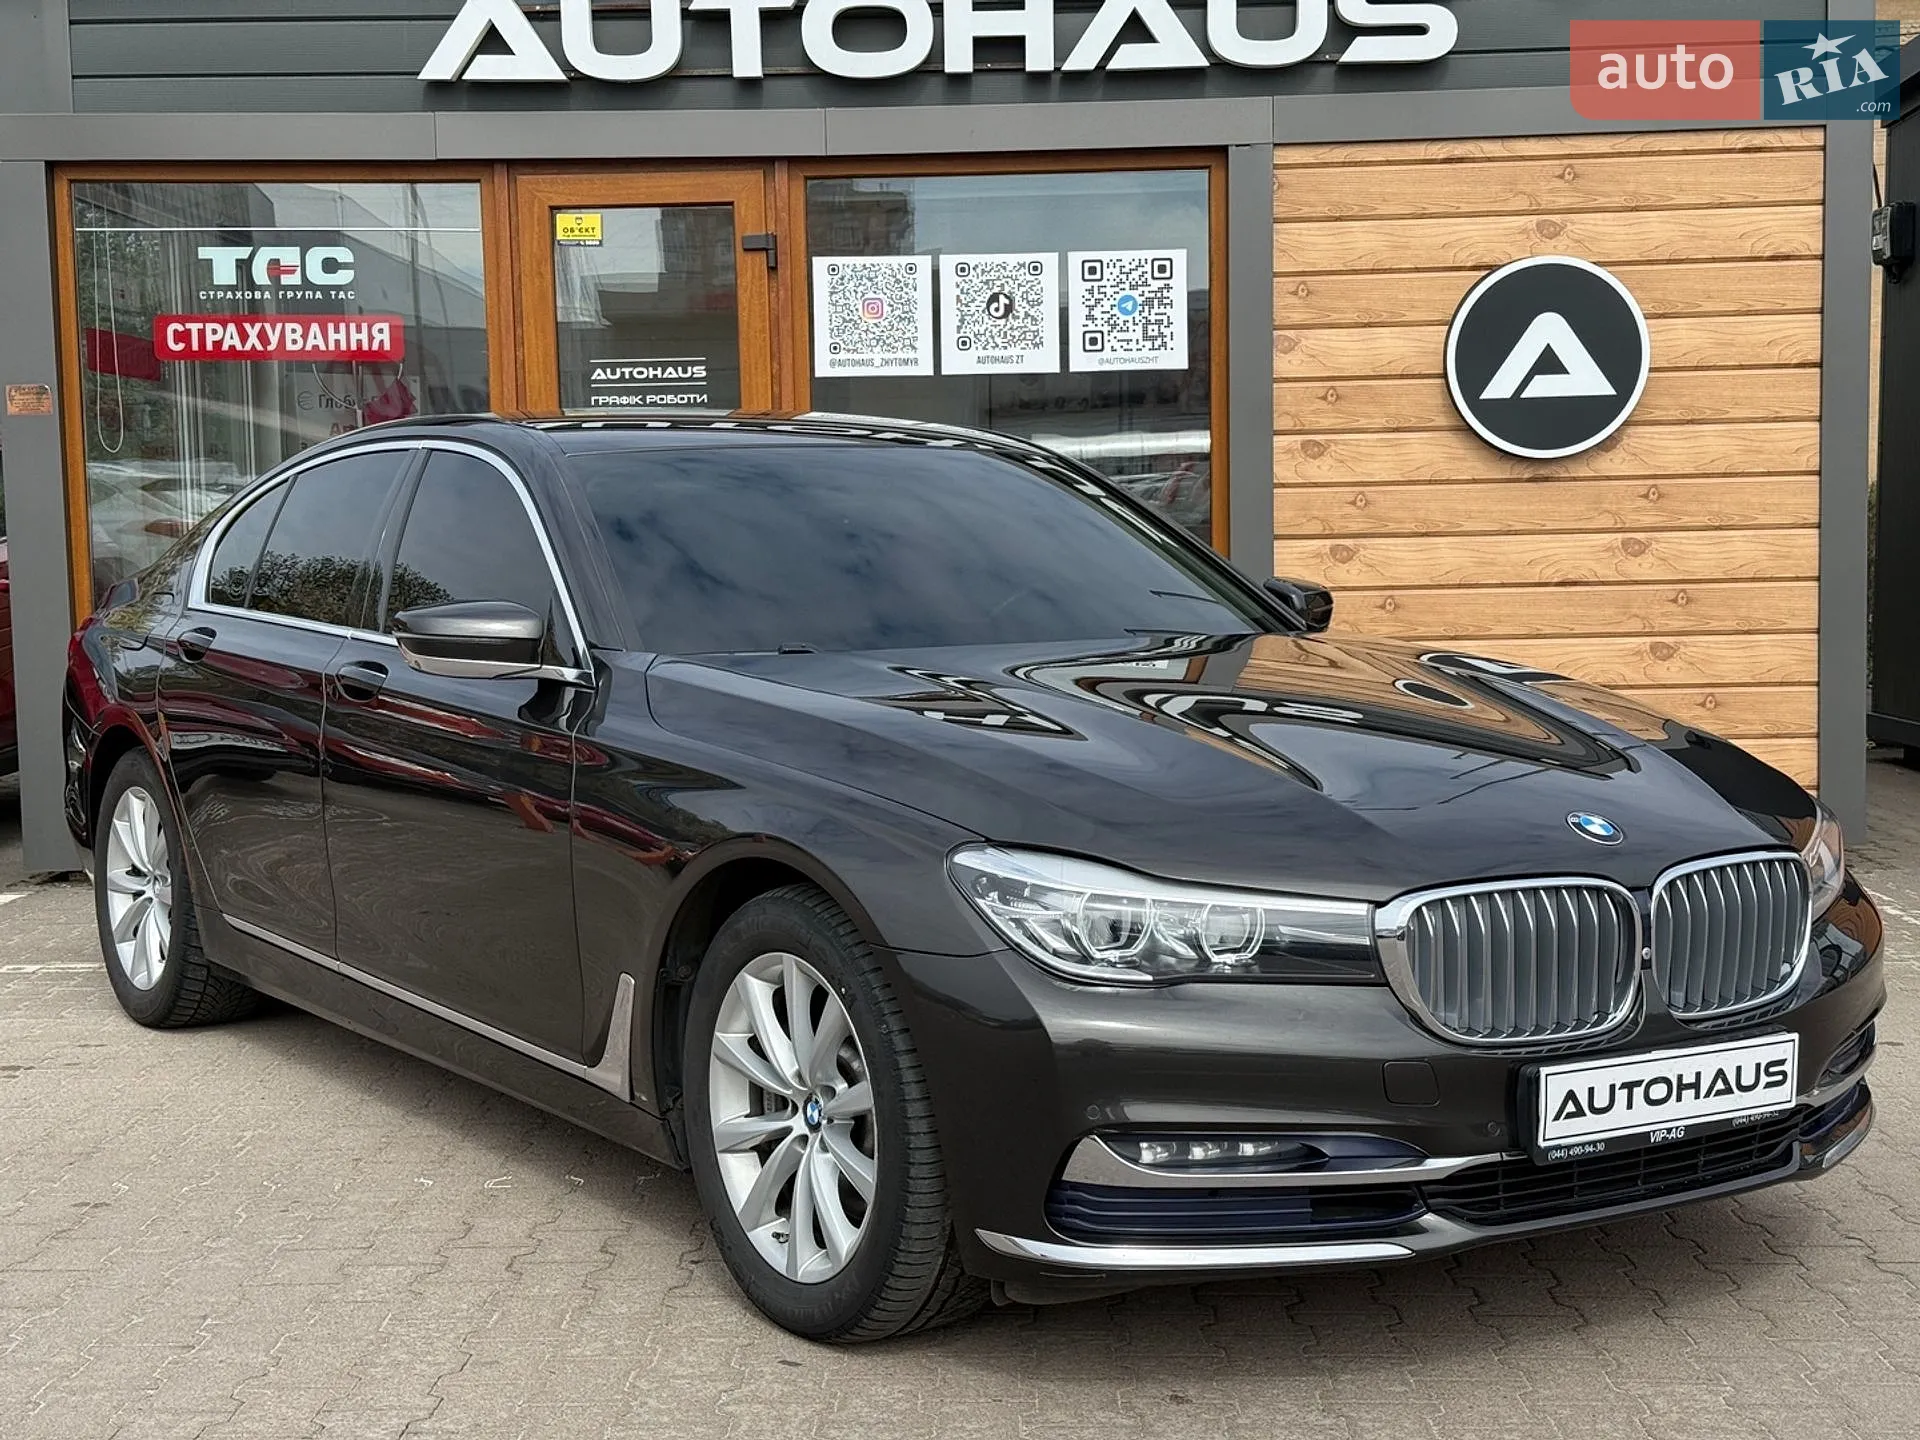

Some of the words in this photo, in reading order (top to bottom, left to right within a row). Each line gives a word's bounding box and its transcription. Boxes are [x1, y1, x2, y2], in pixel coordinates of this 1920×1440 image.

[417, 0, 1458, 82] AUTOHAUS
[199, 290, 271, 300] СТРАХОВА
[278, 290, 323, 300] ГРУПА
[330, 290, 356, 300] ТАС
[166, 322, 391, 352] СТРАХУВАННЯ
[976, 355, 1014, 365] AUTOHAUS
[1015, 354, 1025, 364] ZT
[590, 365, 707, 380] AUTOHAUS
[590, 394, 644, 406] ГРАФІК
[646, 393, 708, 405] РОБОТИ
[1552, 1058, 1788, 1123] AUTOHAUS
[1649, 1126, 1686, 1144] VIP-AG
[1547, 1147, 1568, 1161] (044)
